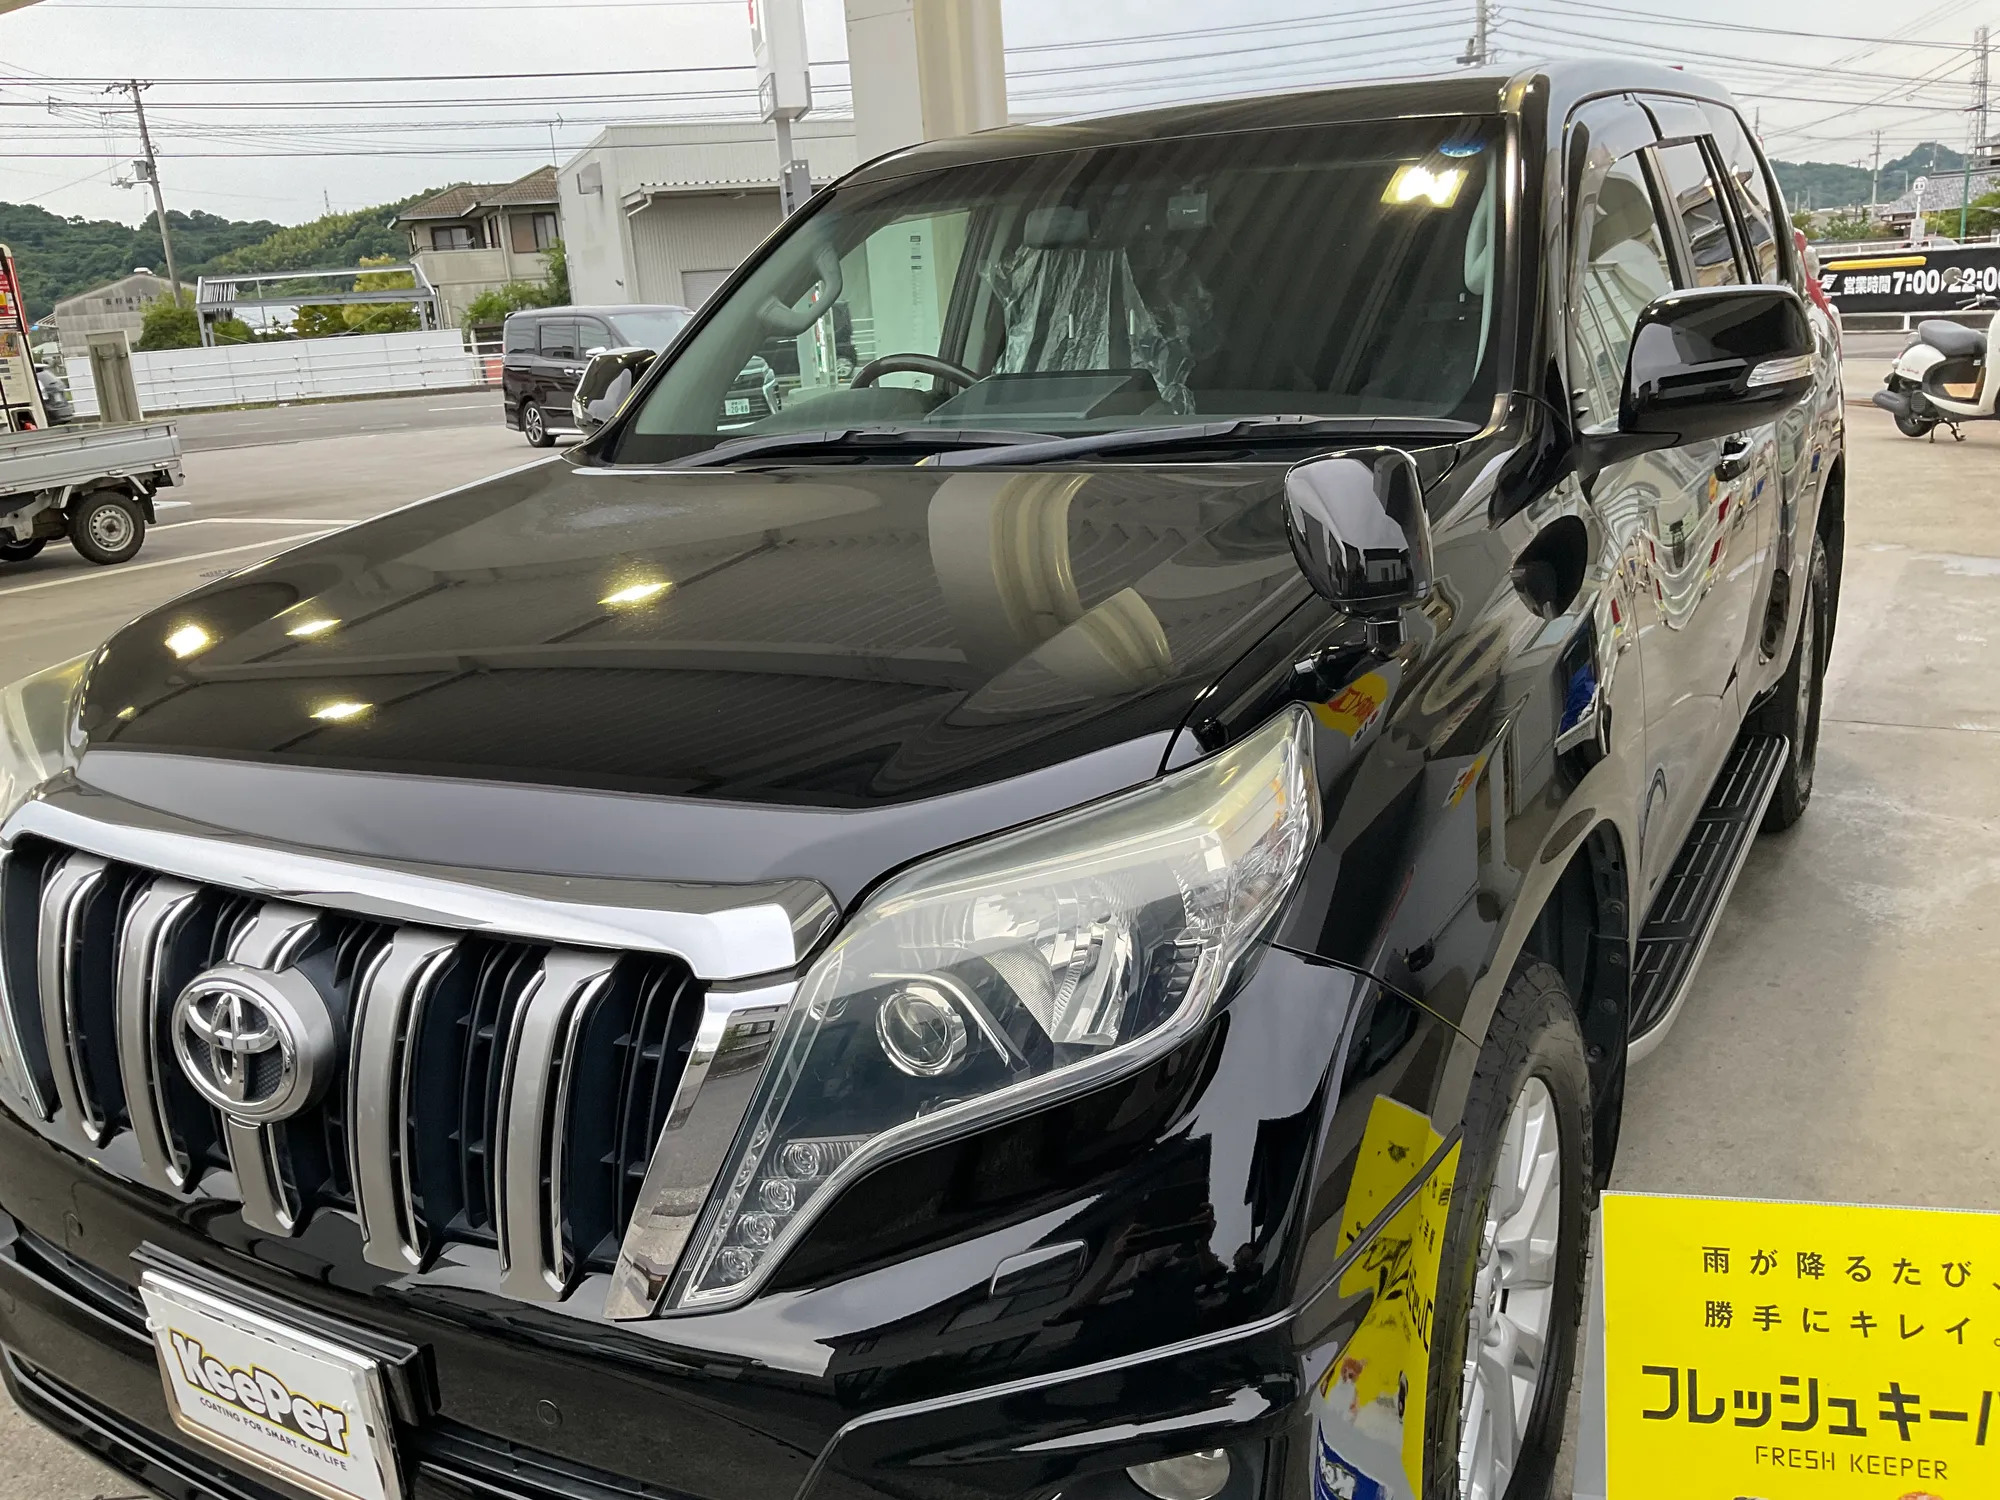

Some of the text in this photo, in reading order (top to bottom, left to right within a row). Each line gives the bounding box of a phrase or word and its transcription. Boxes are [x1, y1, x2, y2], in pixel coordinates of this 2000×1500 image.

[1844, 266, 2000, 295] 営業時間 7:00 2:0
[199, 1397, 348, 1471] COATING FOR SMART CAR LIFE
[1755, 1446, 1948, 1480] FRESH KEEPER
